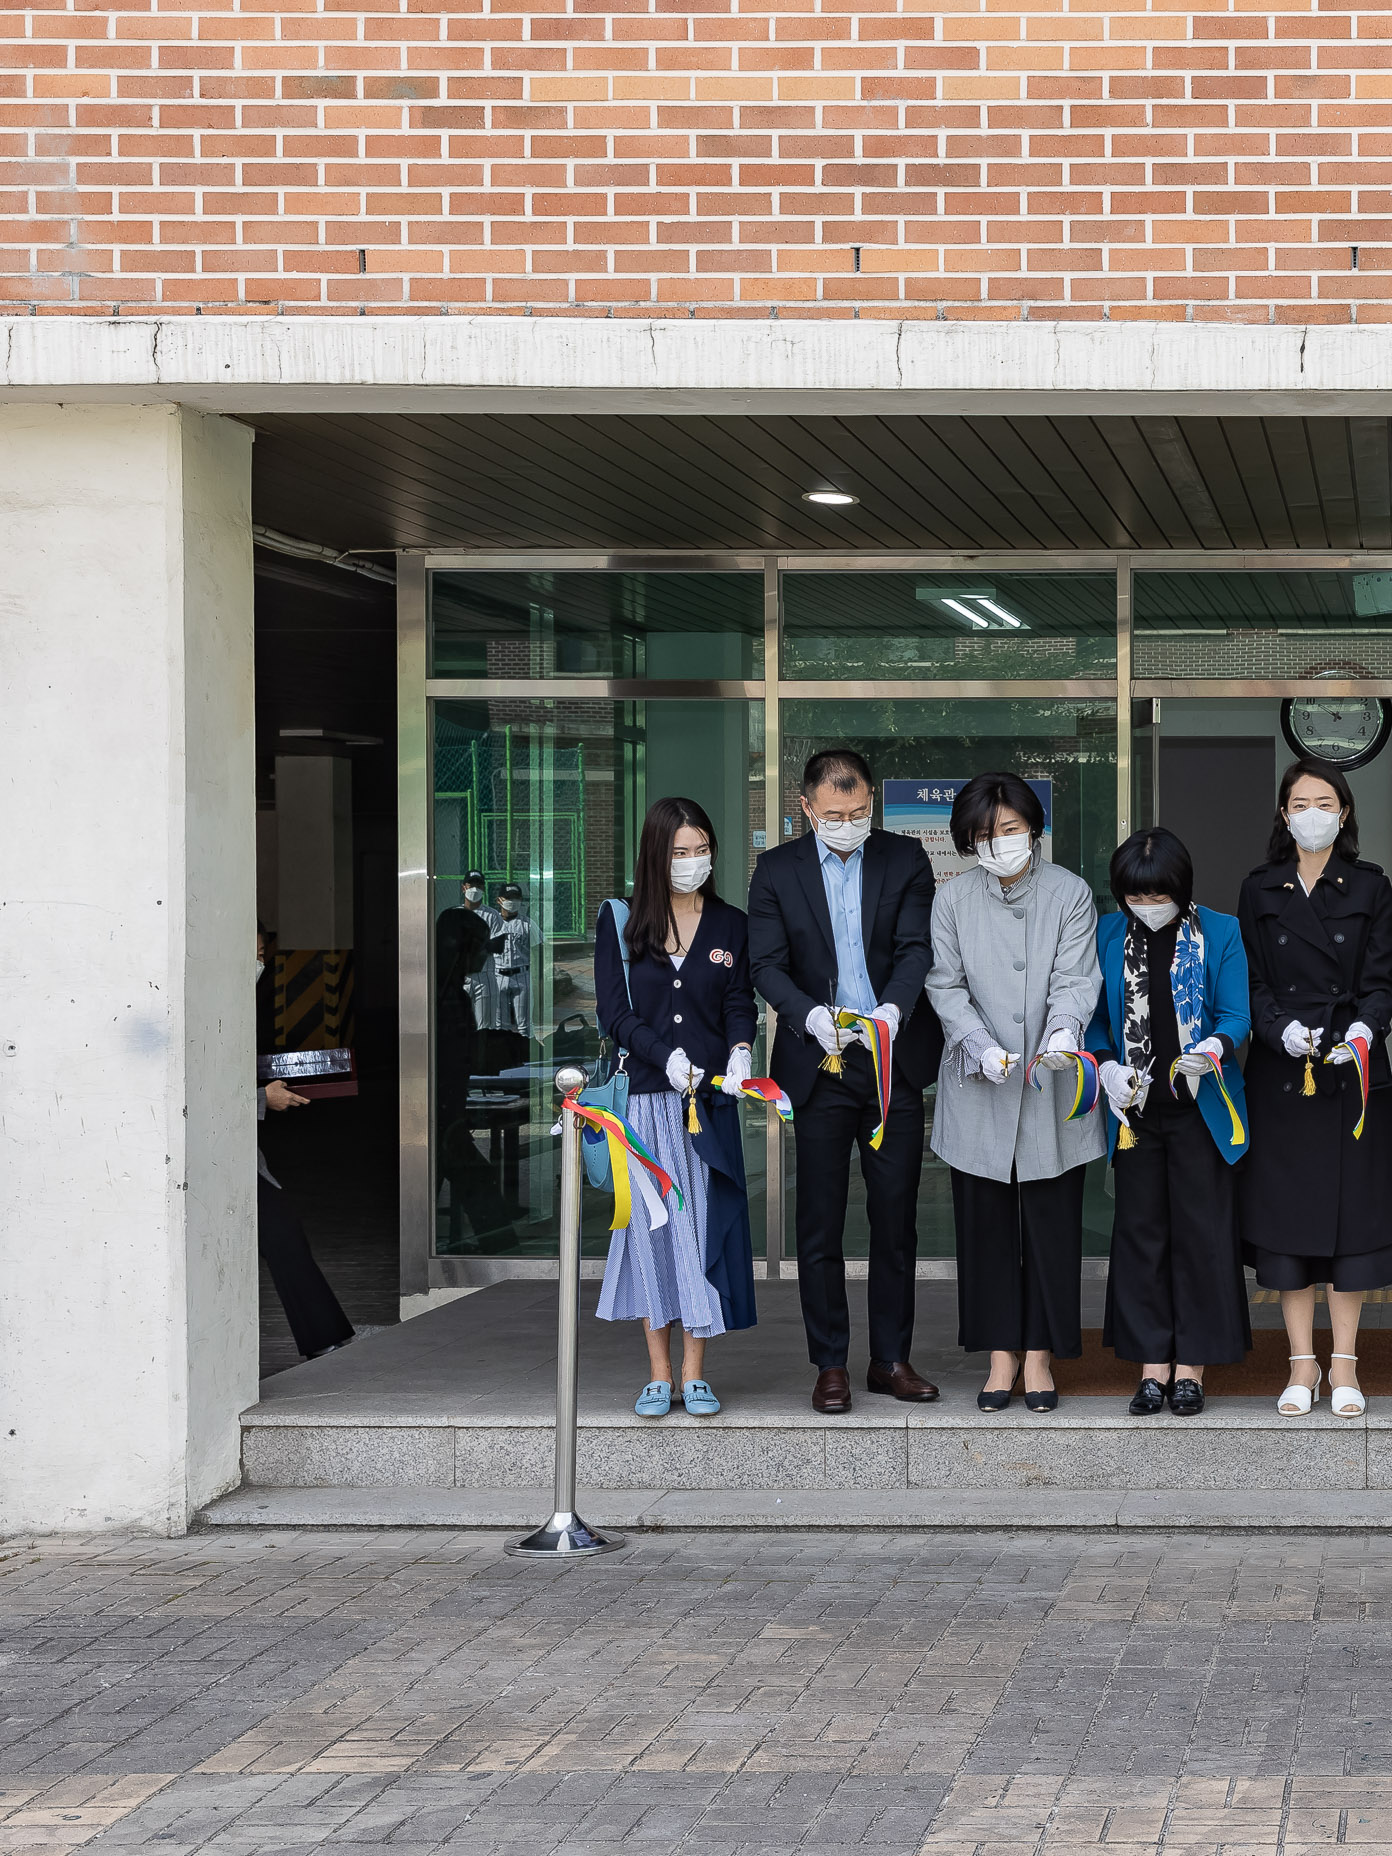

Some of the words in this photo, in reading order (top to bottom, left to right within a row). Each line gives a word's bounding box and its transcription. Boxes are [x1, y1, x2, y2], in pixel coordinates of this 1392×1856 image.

[1360, 697, 1368, 706] 2
[1302, 711, 1310, 720] 9
[1363, 712, 1371, 721] 3
[1306, 726, 1314, 735] 8
[1357, 726, 1366, 736] 4
[1317, 738, 1325, 747] 7
[1332, 742, 1340, 752] 6
[1347, 738, 1355, 747] 5
[917, 788, 957, 802] 체육관
